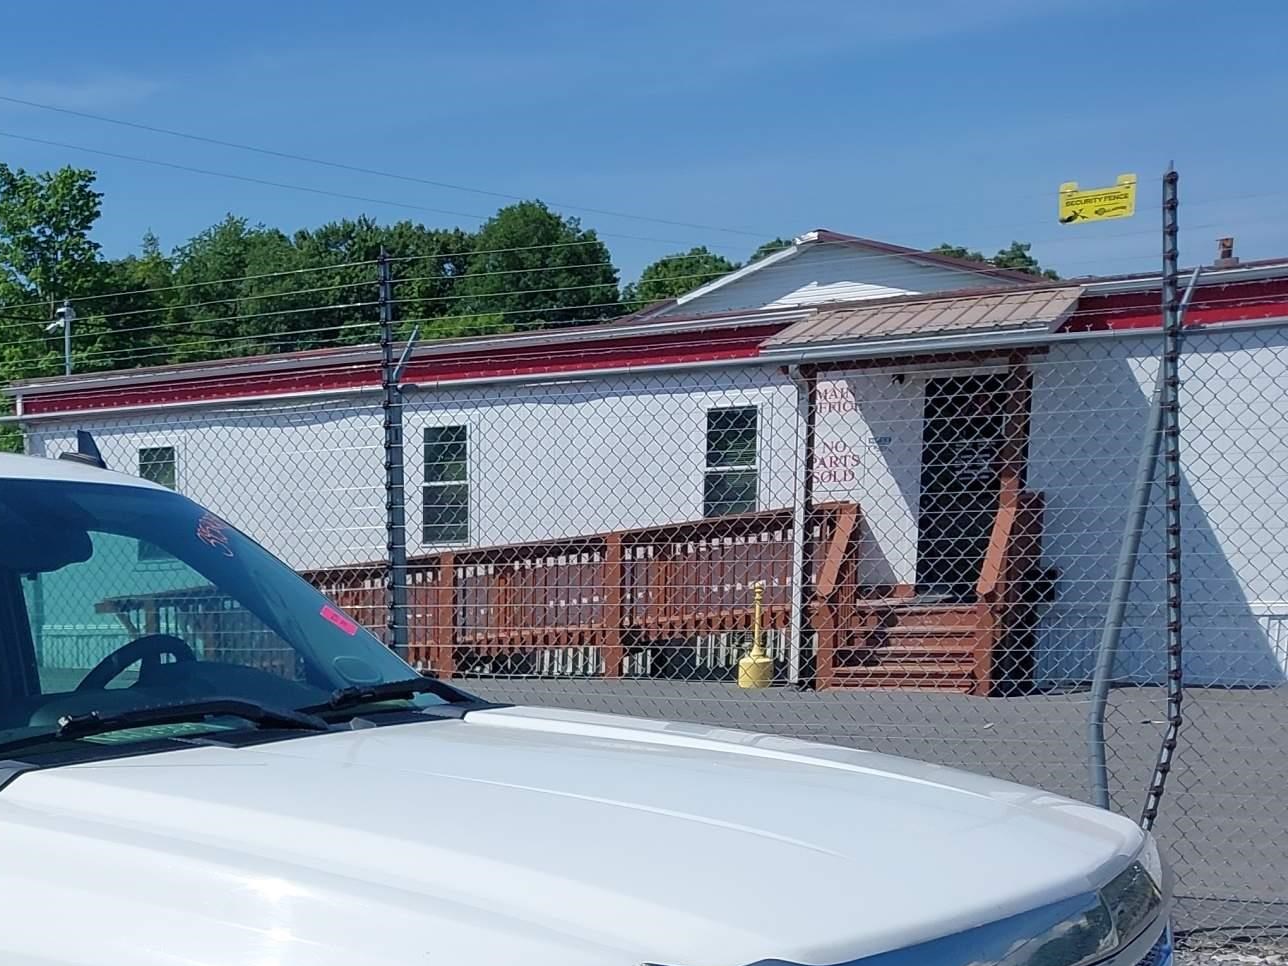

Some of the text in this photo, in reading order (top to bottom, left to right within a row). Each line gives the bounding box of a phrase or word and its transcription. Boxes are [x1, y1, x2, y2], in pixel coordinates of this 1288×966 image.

[1065, 192, 1129, 207] SECURITY FENCE
[822, 440, 846, 453] NO
[813, 455, 861, 469] PARTS
[812, 470, 855, 484] SOLD
